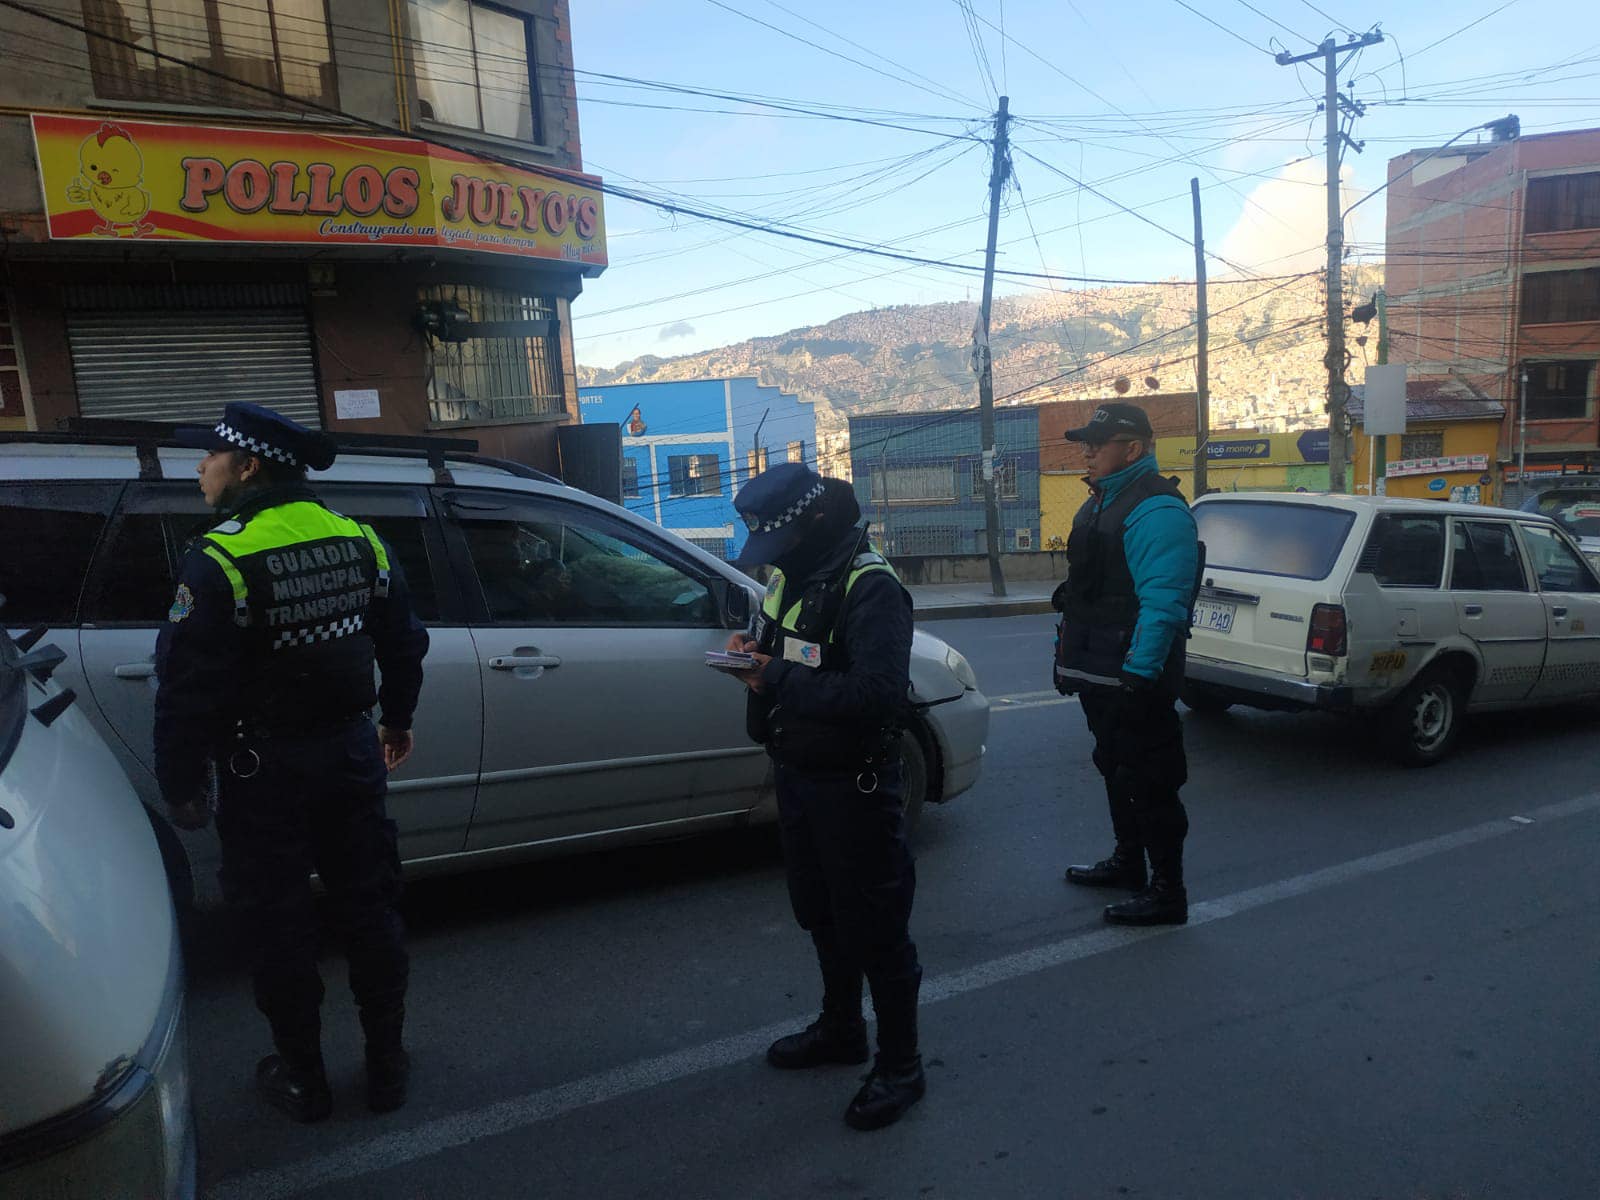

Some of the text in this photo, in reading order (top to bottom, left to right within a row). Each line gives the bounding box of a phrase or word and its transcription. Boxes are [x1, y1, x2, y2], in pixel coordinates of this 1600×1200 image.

[180, 156, 598, 241] POLLOS JULYO'S
[319, 218, 414, 241] Construyendo
[417, 226, 436, 236] un
[440, 225, 474, 243] legado
[266, 541, 362, 576] GUARDIA
[272, 565, 366, 601] MUNICIPAL
[265, 587, 372, 626] TRANSPORTE
